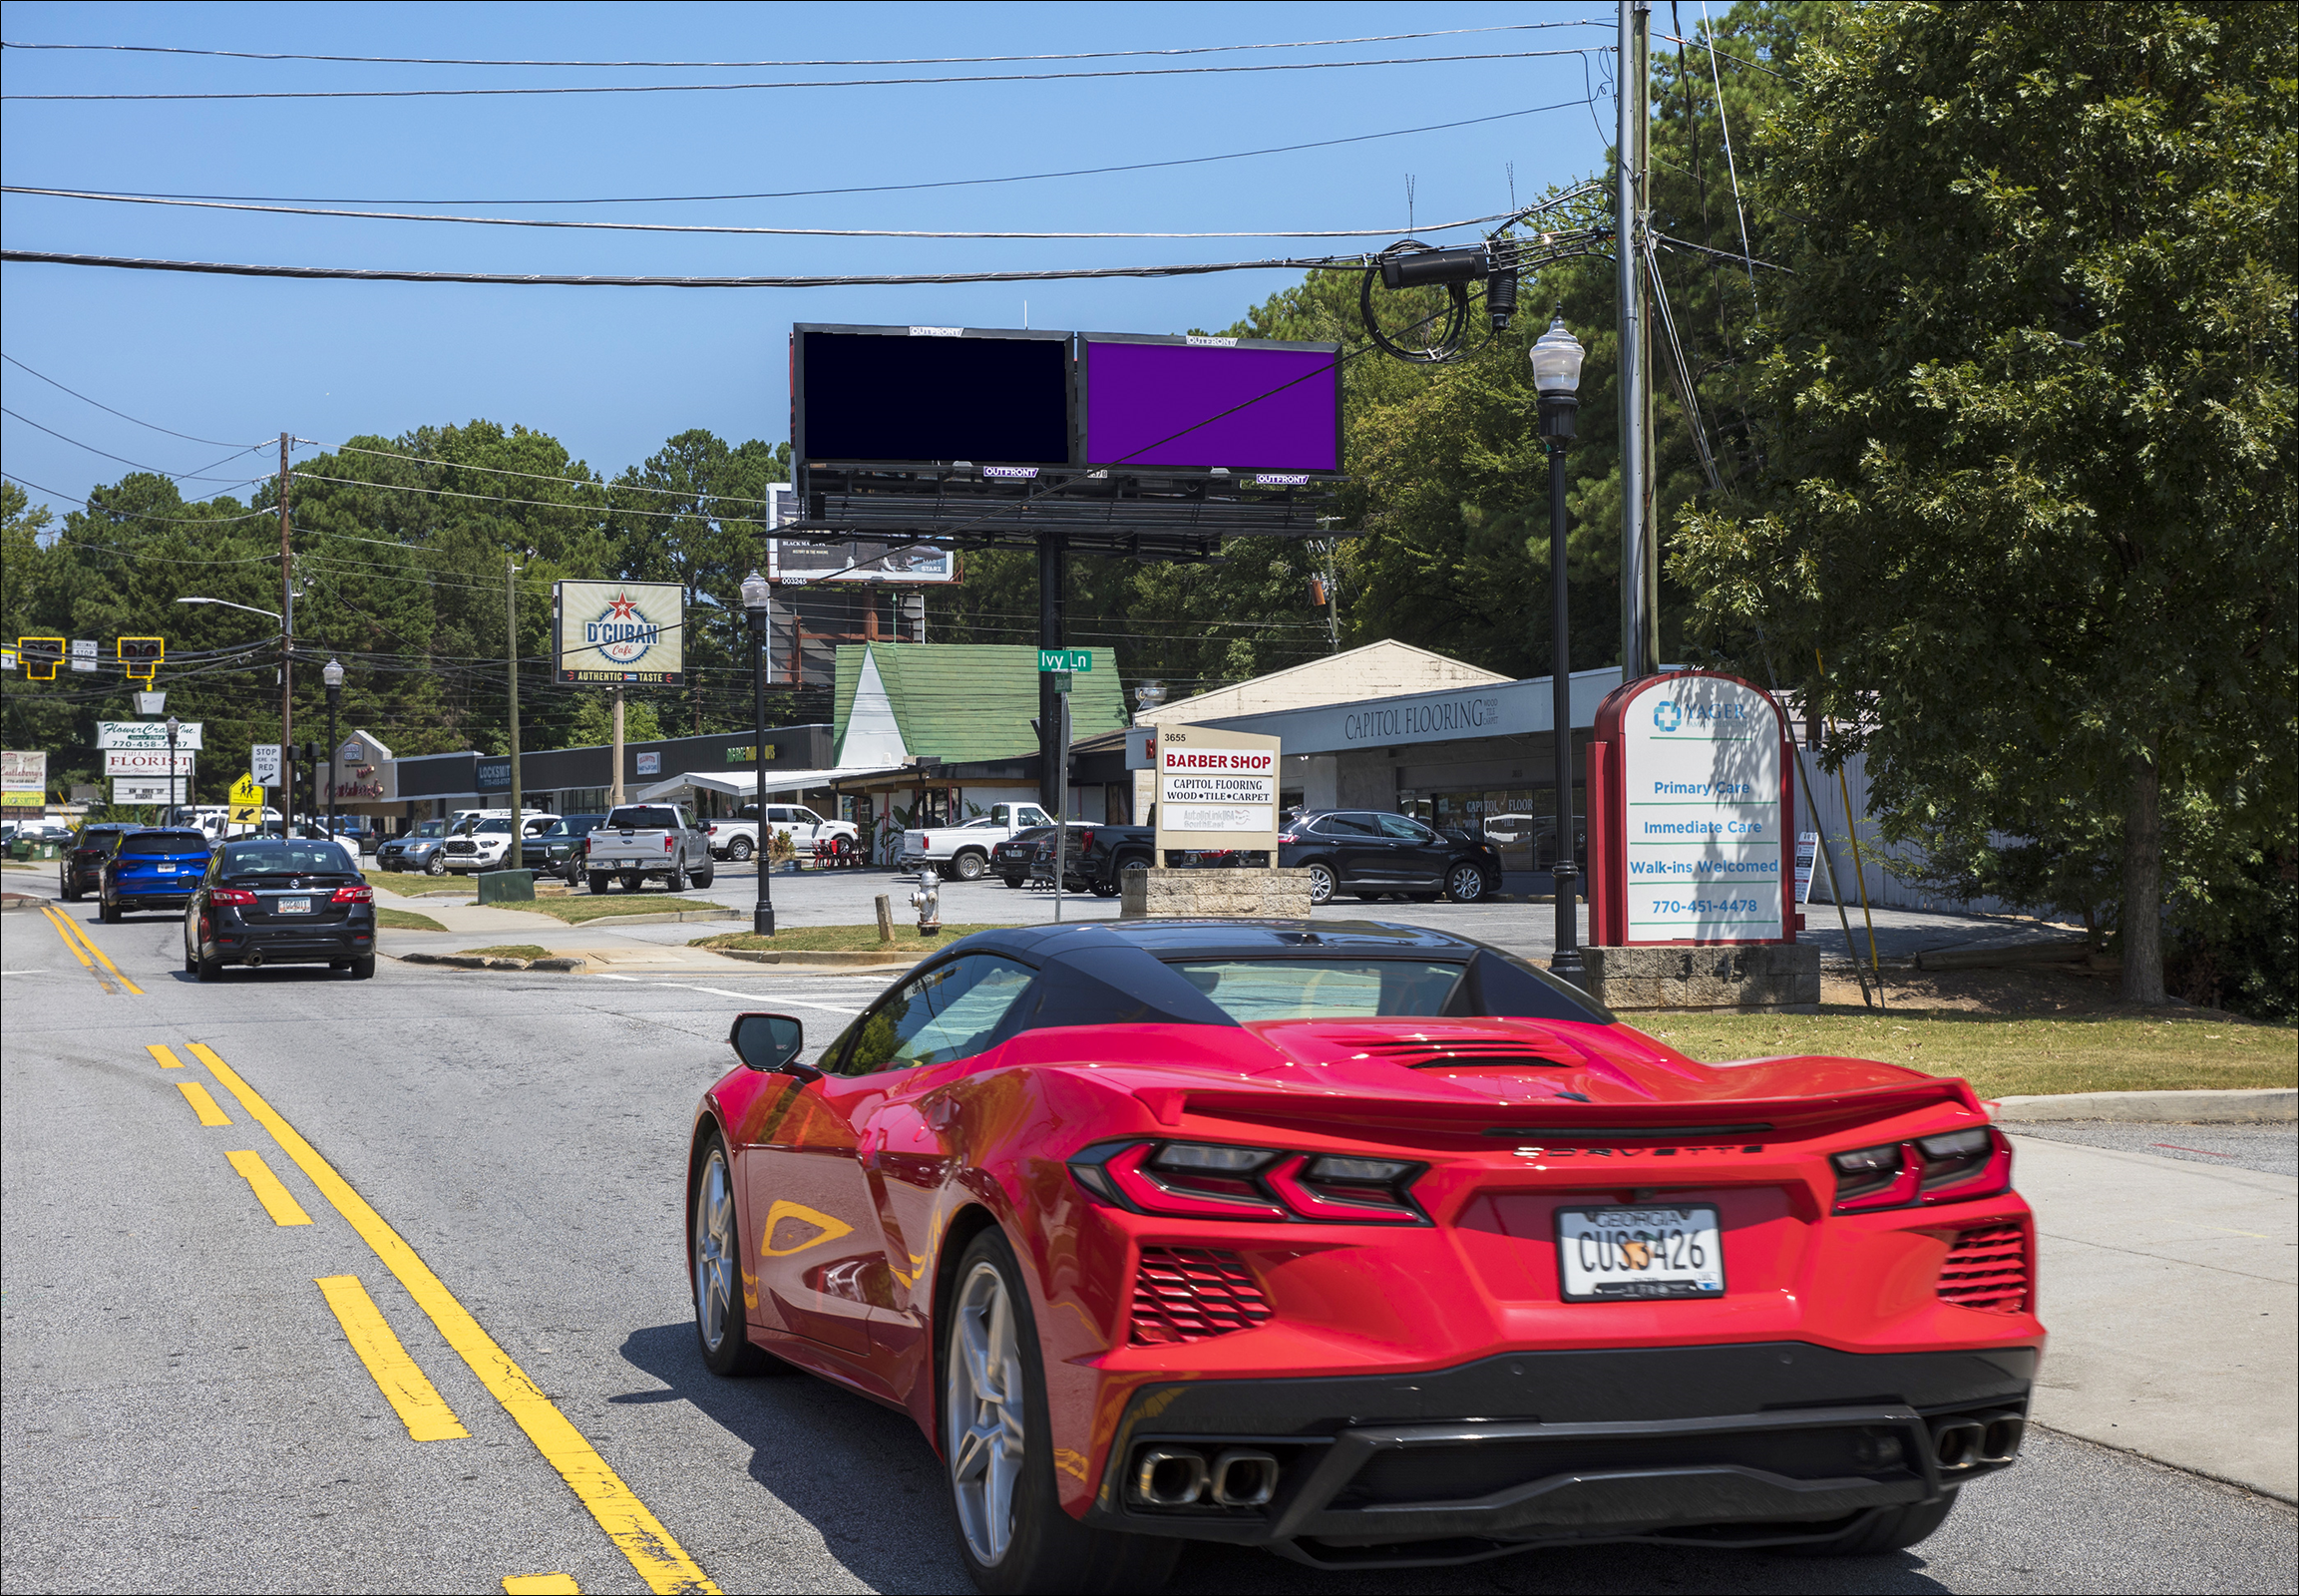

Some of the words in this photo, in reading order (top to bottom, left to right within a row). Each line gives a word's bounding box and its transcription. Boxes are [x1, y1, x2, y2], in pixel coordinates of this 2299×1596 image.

[985, 468, 1034, 477] OUTFRONT
[1258, 475, 1306, 484] OUTFRONT
[612, 644, 633, 656] Café
[1042, 651, 1064, 669] Ivy
[1069, 651, 1086, 667] Ln
[578, 671, 622, 681] AUTHENTIC
[639, 673, 662, 682] TASTE
[1686, 703, 1747, 719] YAGER
[1345, 709, 1400, 740] CAPITOL
[1405, 699, 1483, 733] FLOORING
[1164, 733, 1186, 742] 3655
[110, 757, 189, 766] FLORIST
[1166, 753, 1228, 768] BARBER
[1230, 755, 1272, 769] SHOP
[479, 764, 511, 779] LOCKSMIT
[1173, 779, 1213, 789] CAPITOL
[1215, 779, 1263, 790] FLOORING
[1654, 781, 1711, 796] Primary
[1716, 781, 1749, 794] Care
[1167, 791, 1198, 800] WOOD
[1204, 792, 1226, 801] TILE
[1644, 820, 1723, 834] Immediate
[1727, 820, 1762, 834] Care
[1630, 861, 1693, 874] Walk-ins
[1698, 859, 1778, 873] Welcomed
[1653, 900, 1757, 914] 770-451-4478
[1596, 1210, 1683, 1228] GEORGIA
